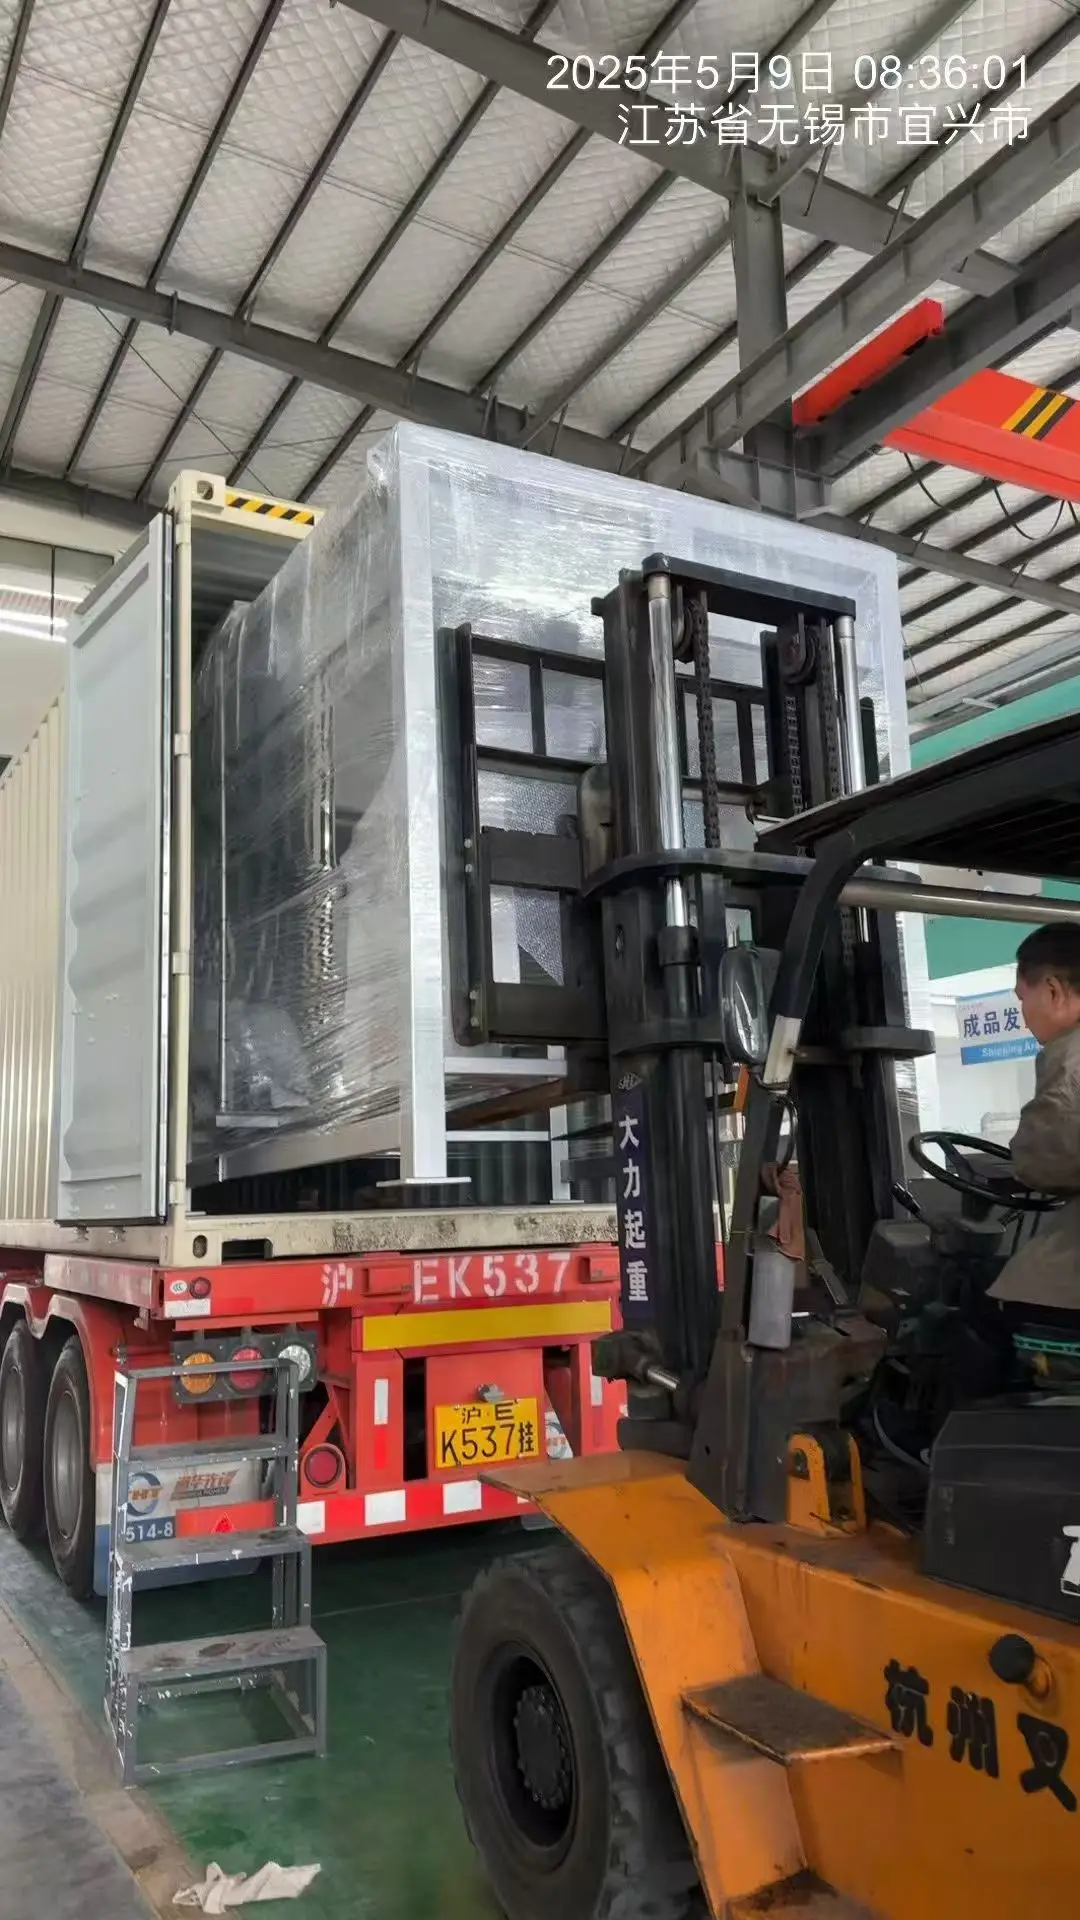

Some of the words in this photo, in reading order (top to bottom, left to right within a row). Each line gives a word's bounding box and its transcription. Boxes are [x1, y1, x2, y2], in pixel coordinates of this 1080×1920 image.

[618, 1115, 649, 1302] 大力起重
[413, 1251, 571, 1303] EK537
[441, 1421, 535, 1464] K537挂
[125, 1521, 173, 1543] 514-8
